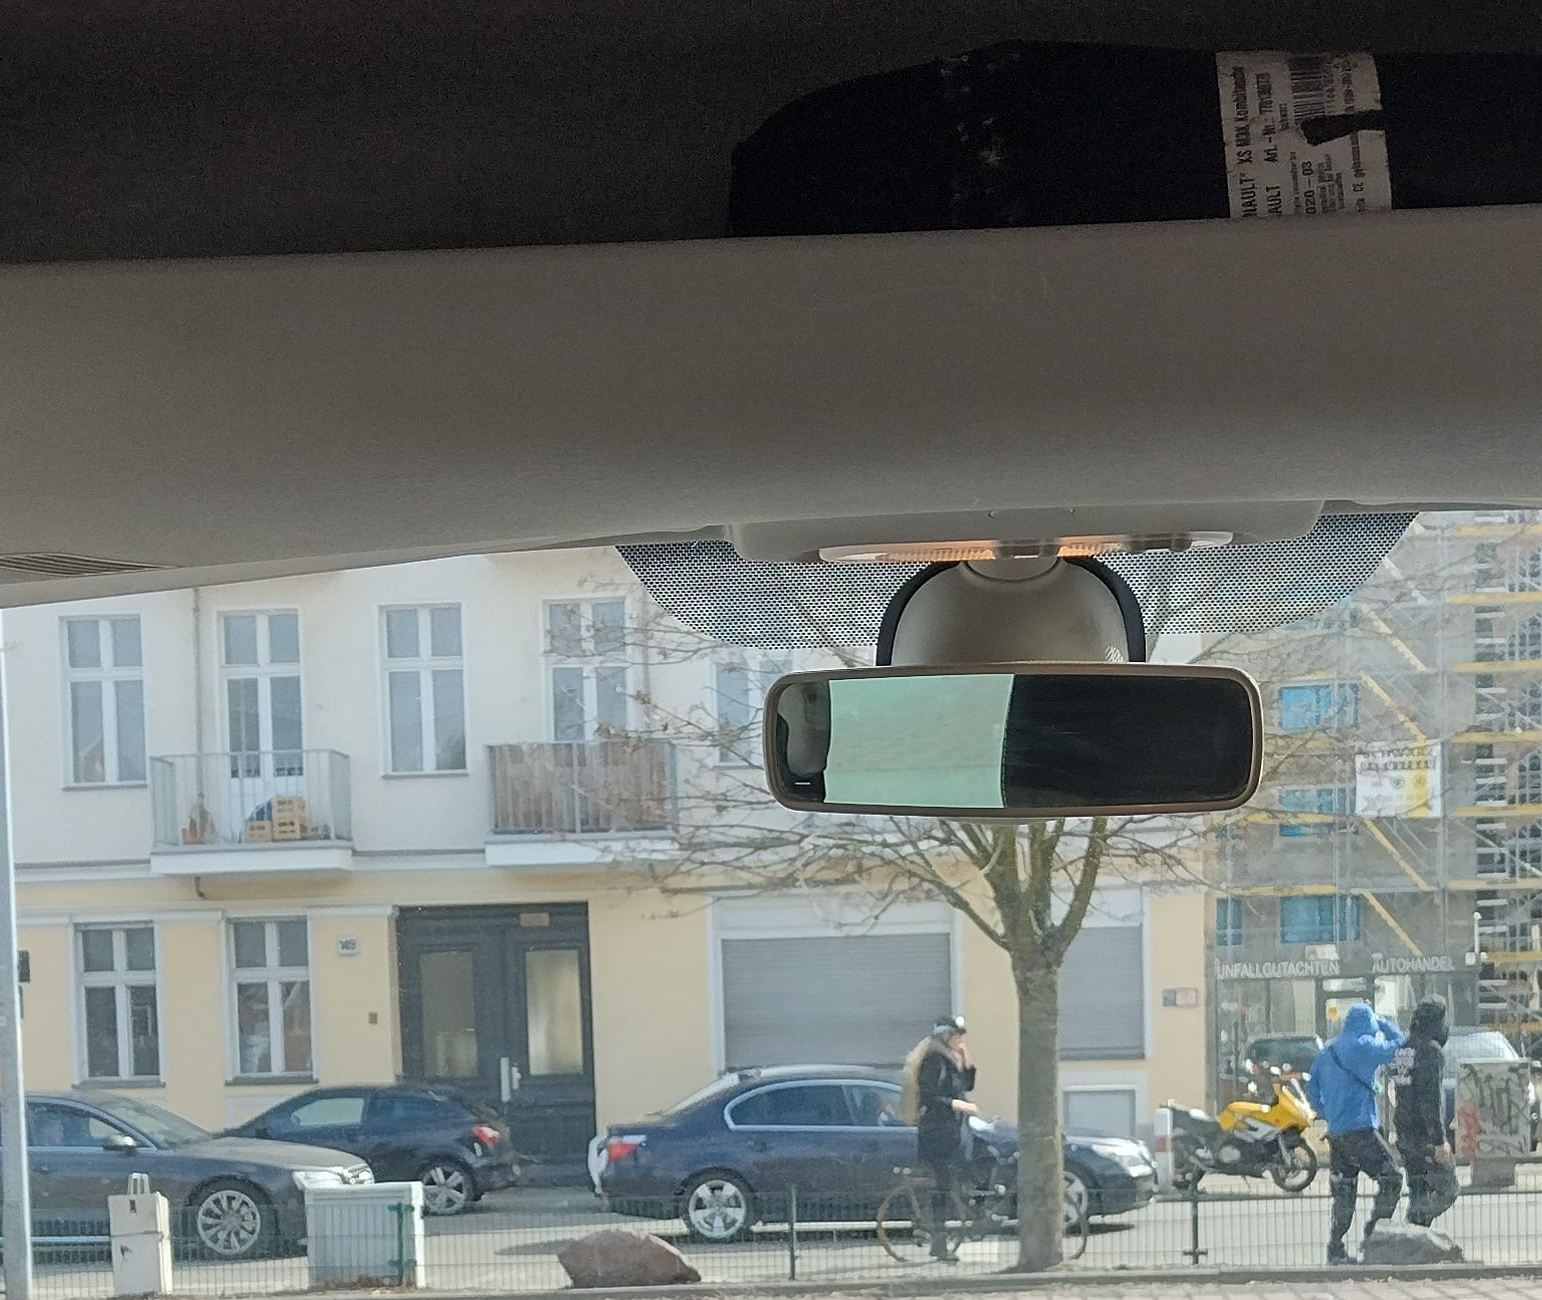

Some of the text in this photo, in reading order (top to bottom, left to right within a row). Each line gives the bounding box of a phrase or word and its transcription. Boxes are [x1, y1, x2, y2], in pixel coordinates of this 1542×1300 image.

[1239, 177, 1258, 218] NAULT
[1265, 186, 1283, 214] AULT
[1371, 953, 1455, 972] AUTOHANDEL
